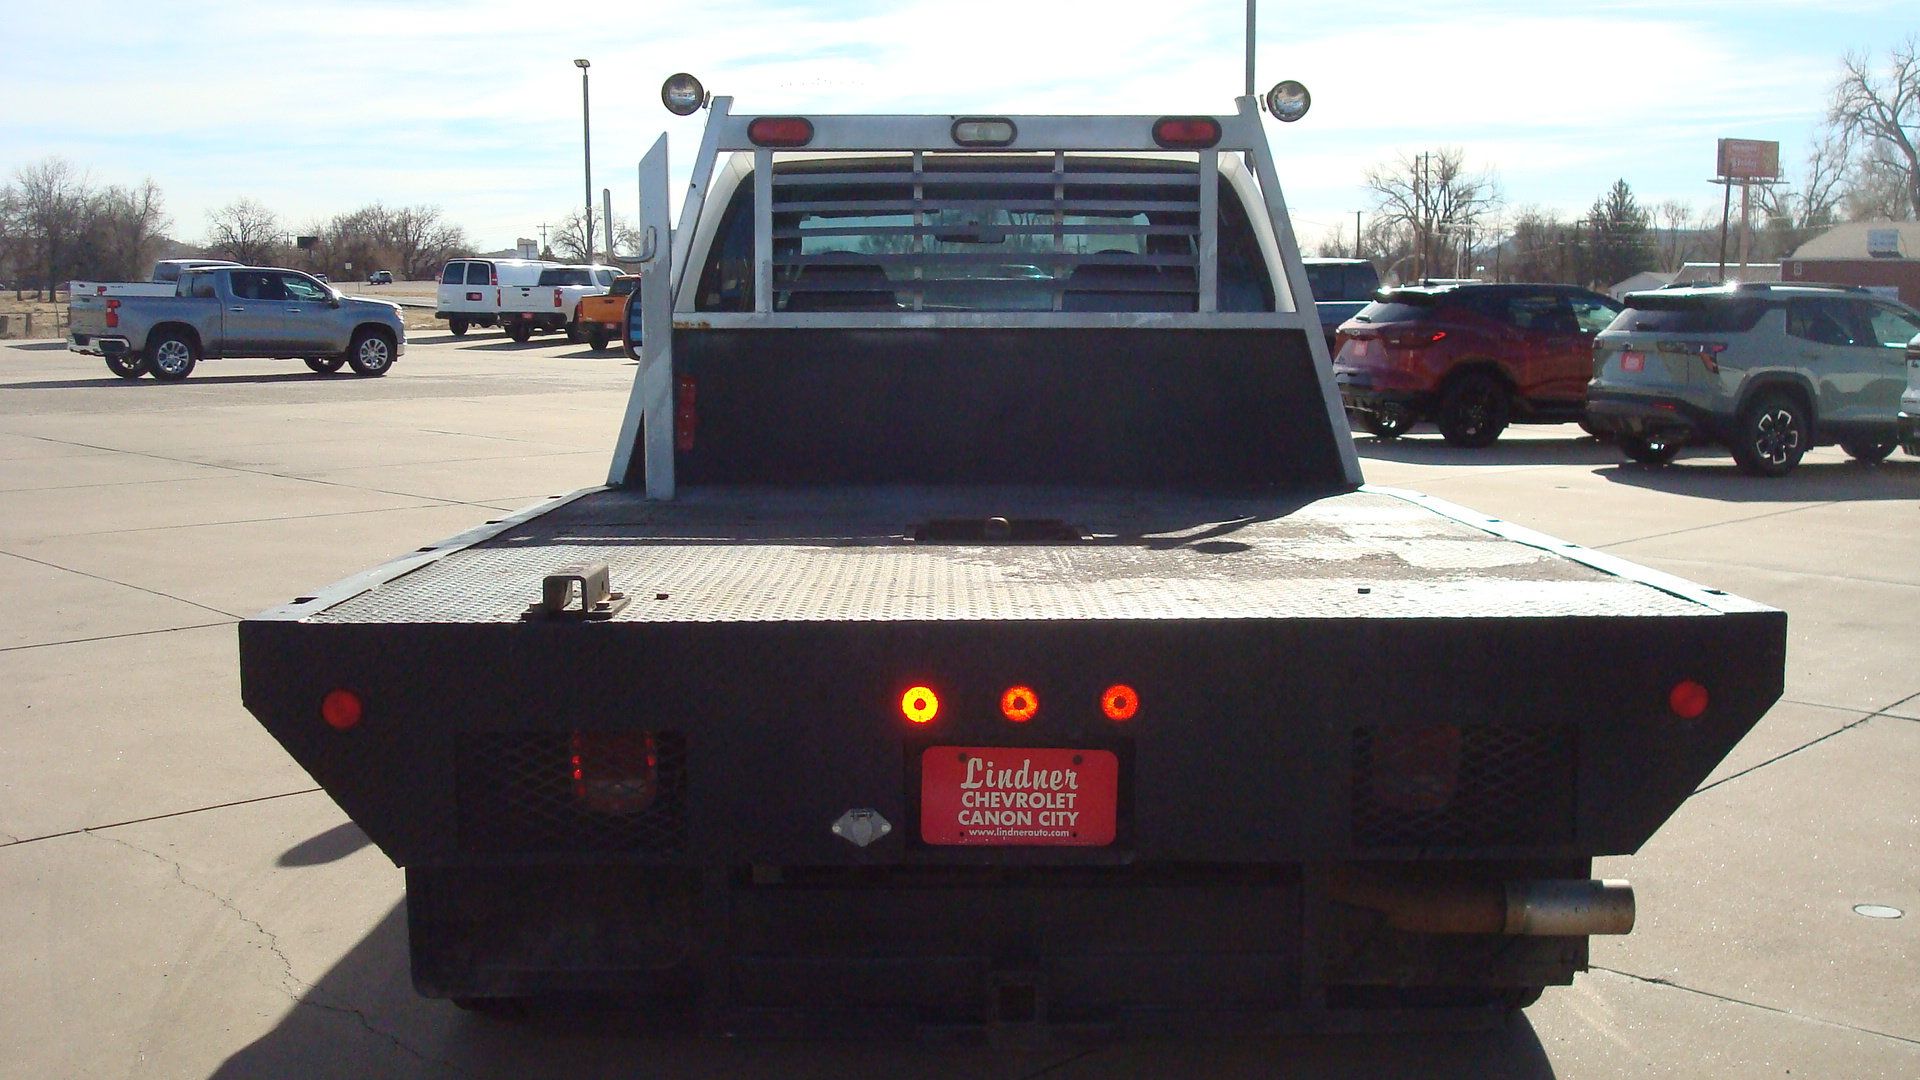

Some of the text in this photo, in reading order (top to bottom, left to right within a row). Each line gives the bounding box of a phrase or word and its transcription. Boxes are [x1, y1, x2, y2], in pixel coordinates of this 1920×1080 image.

[960, 757, 1079, 791] Lindner
[962, 791, 1077, 809] CHEVROLET
[958, 809, 1079, 827] CANON CITY
[968, 827, 1070, 837] www.lindnerauto.com
